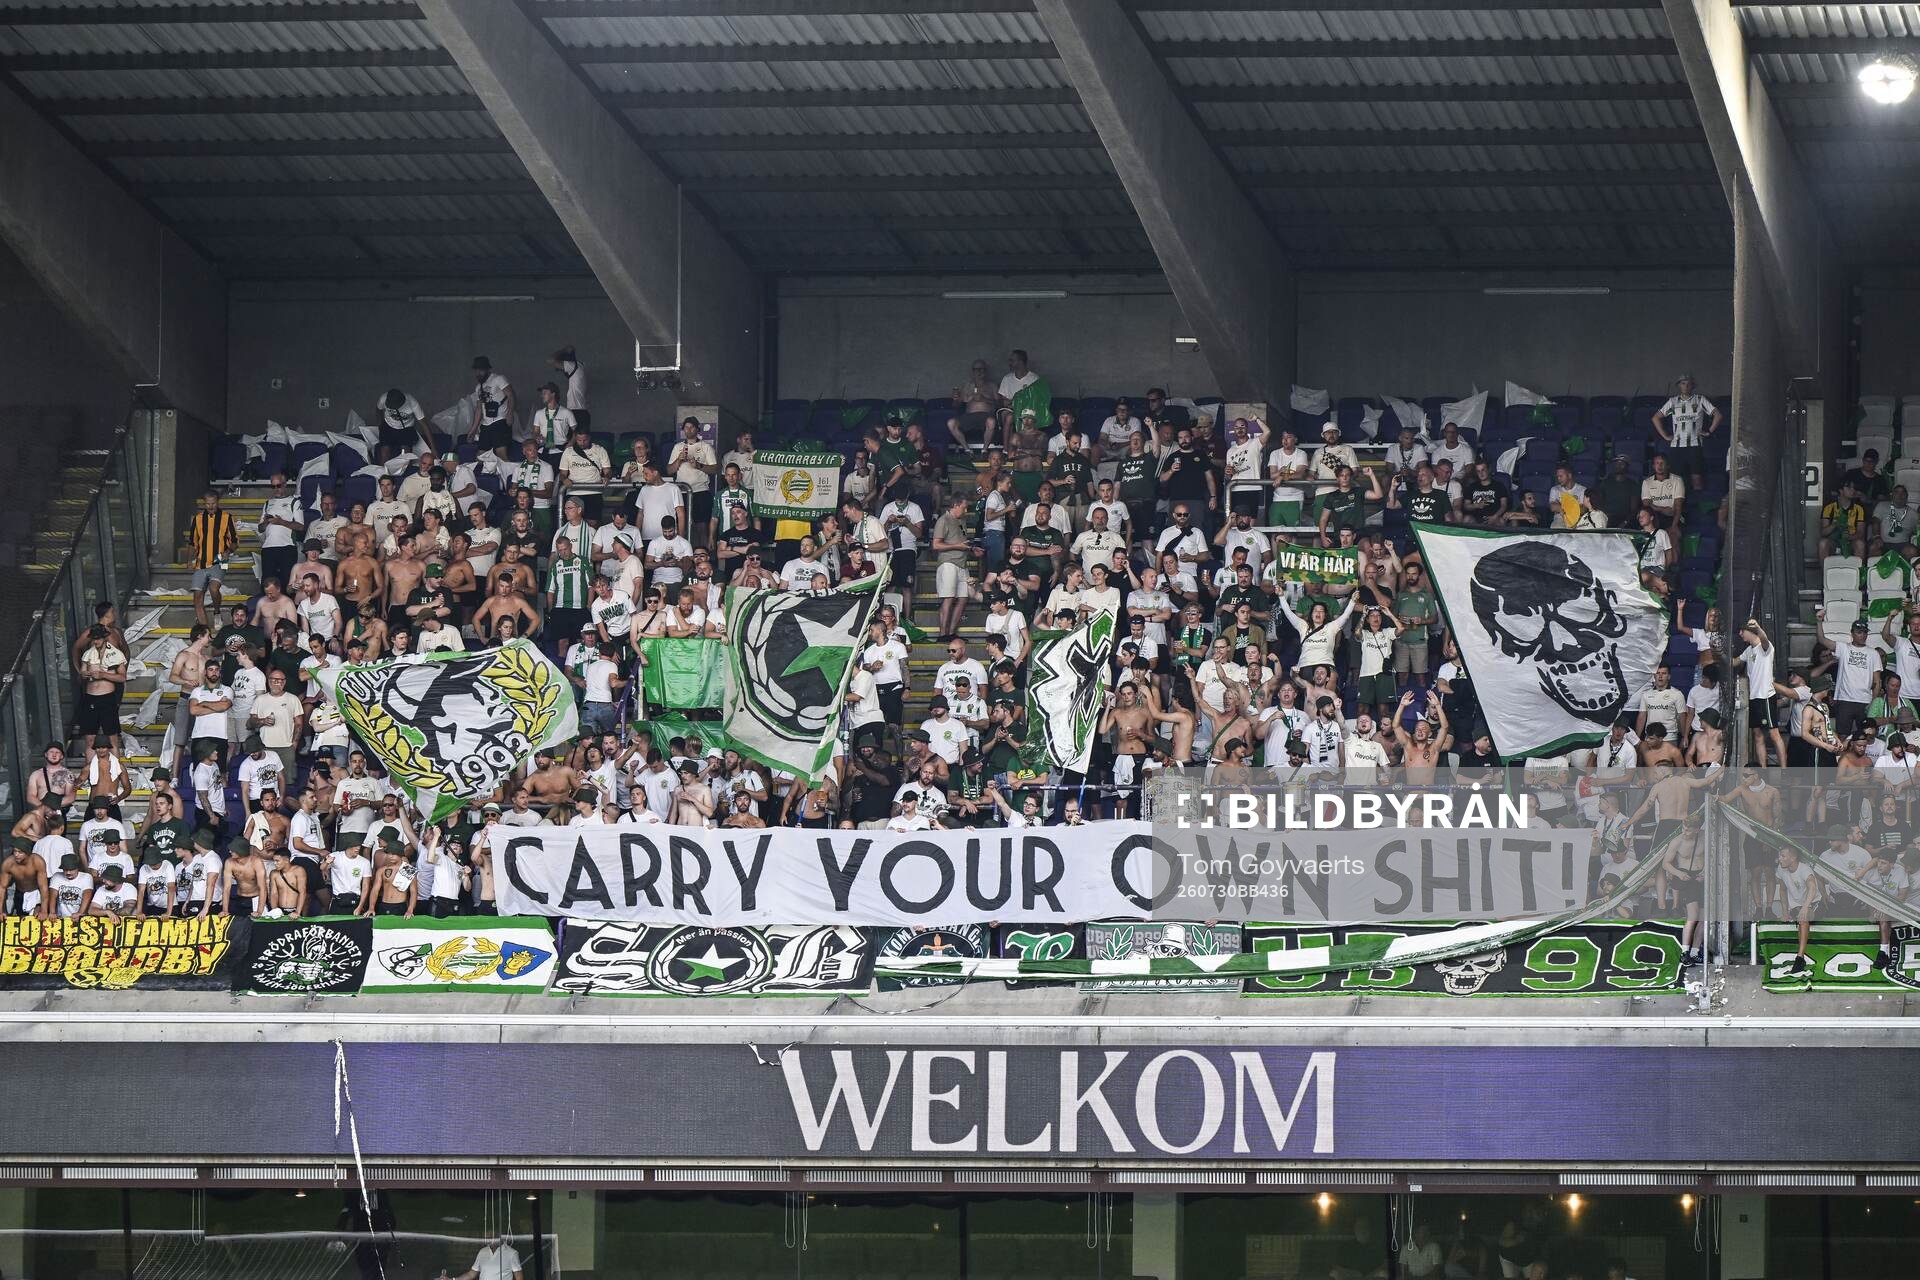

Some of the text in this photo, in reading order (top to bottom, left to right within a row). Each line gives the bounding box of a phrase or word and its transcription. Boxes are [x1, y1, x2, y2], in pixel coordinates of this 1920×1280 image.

[760, 453, 825, 464] HAMMARBY
[1063, 463, 1083, 472] HIF
[1280, 552, 1354, 575] VI ÄR HÄR
[1354, 751, 1377, 762] Revolut
[505, 832, 1575, 920] CARRY YOUR OWN SHIT!
[4, 914, 232, 947] FOREST FAMILY
[675, 927, 753, 947] Mer än passion
[780, 1048, 1336, 1156] WELKOM
